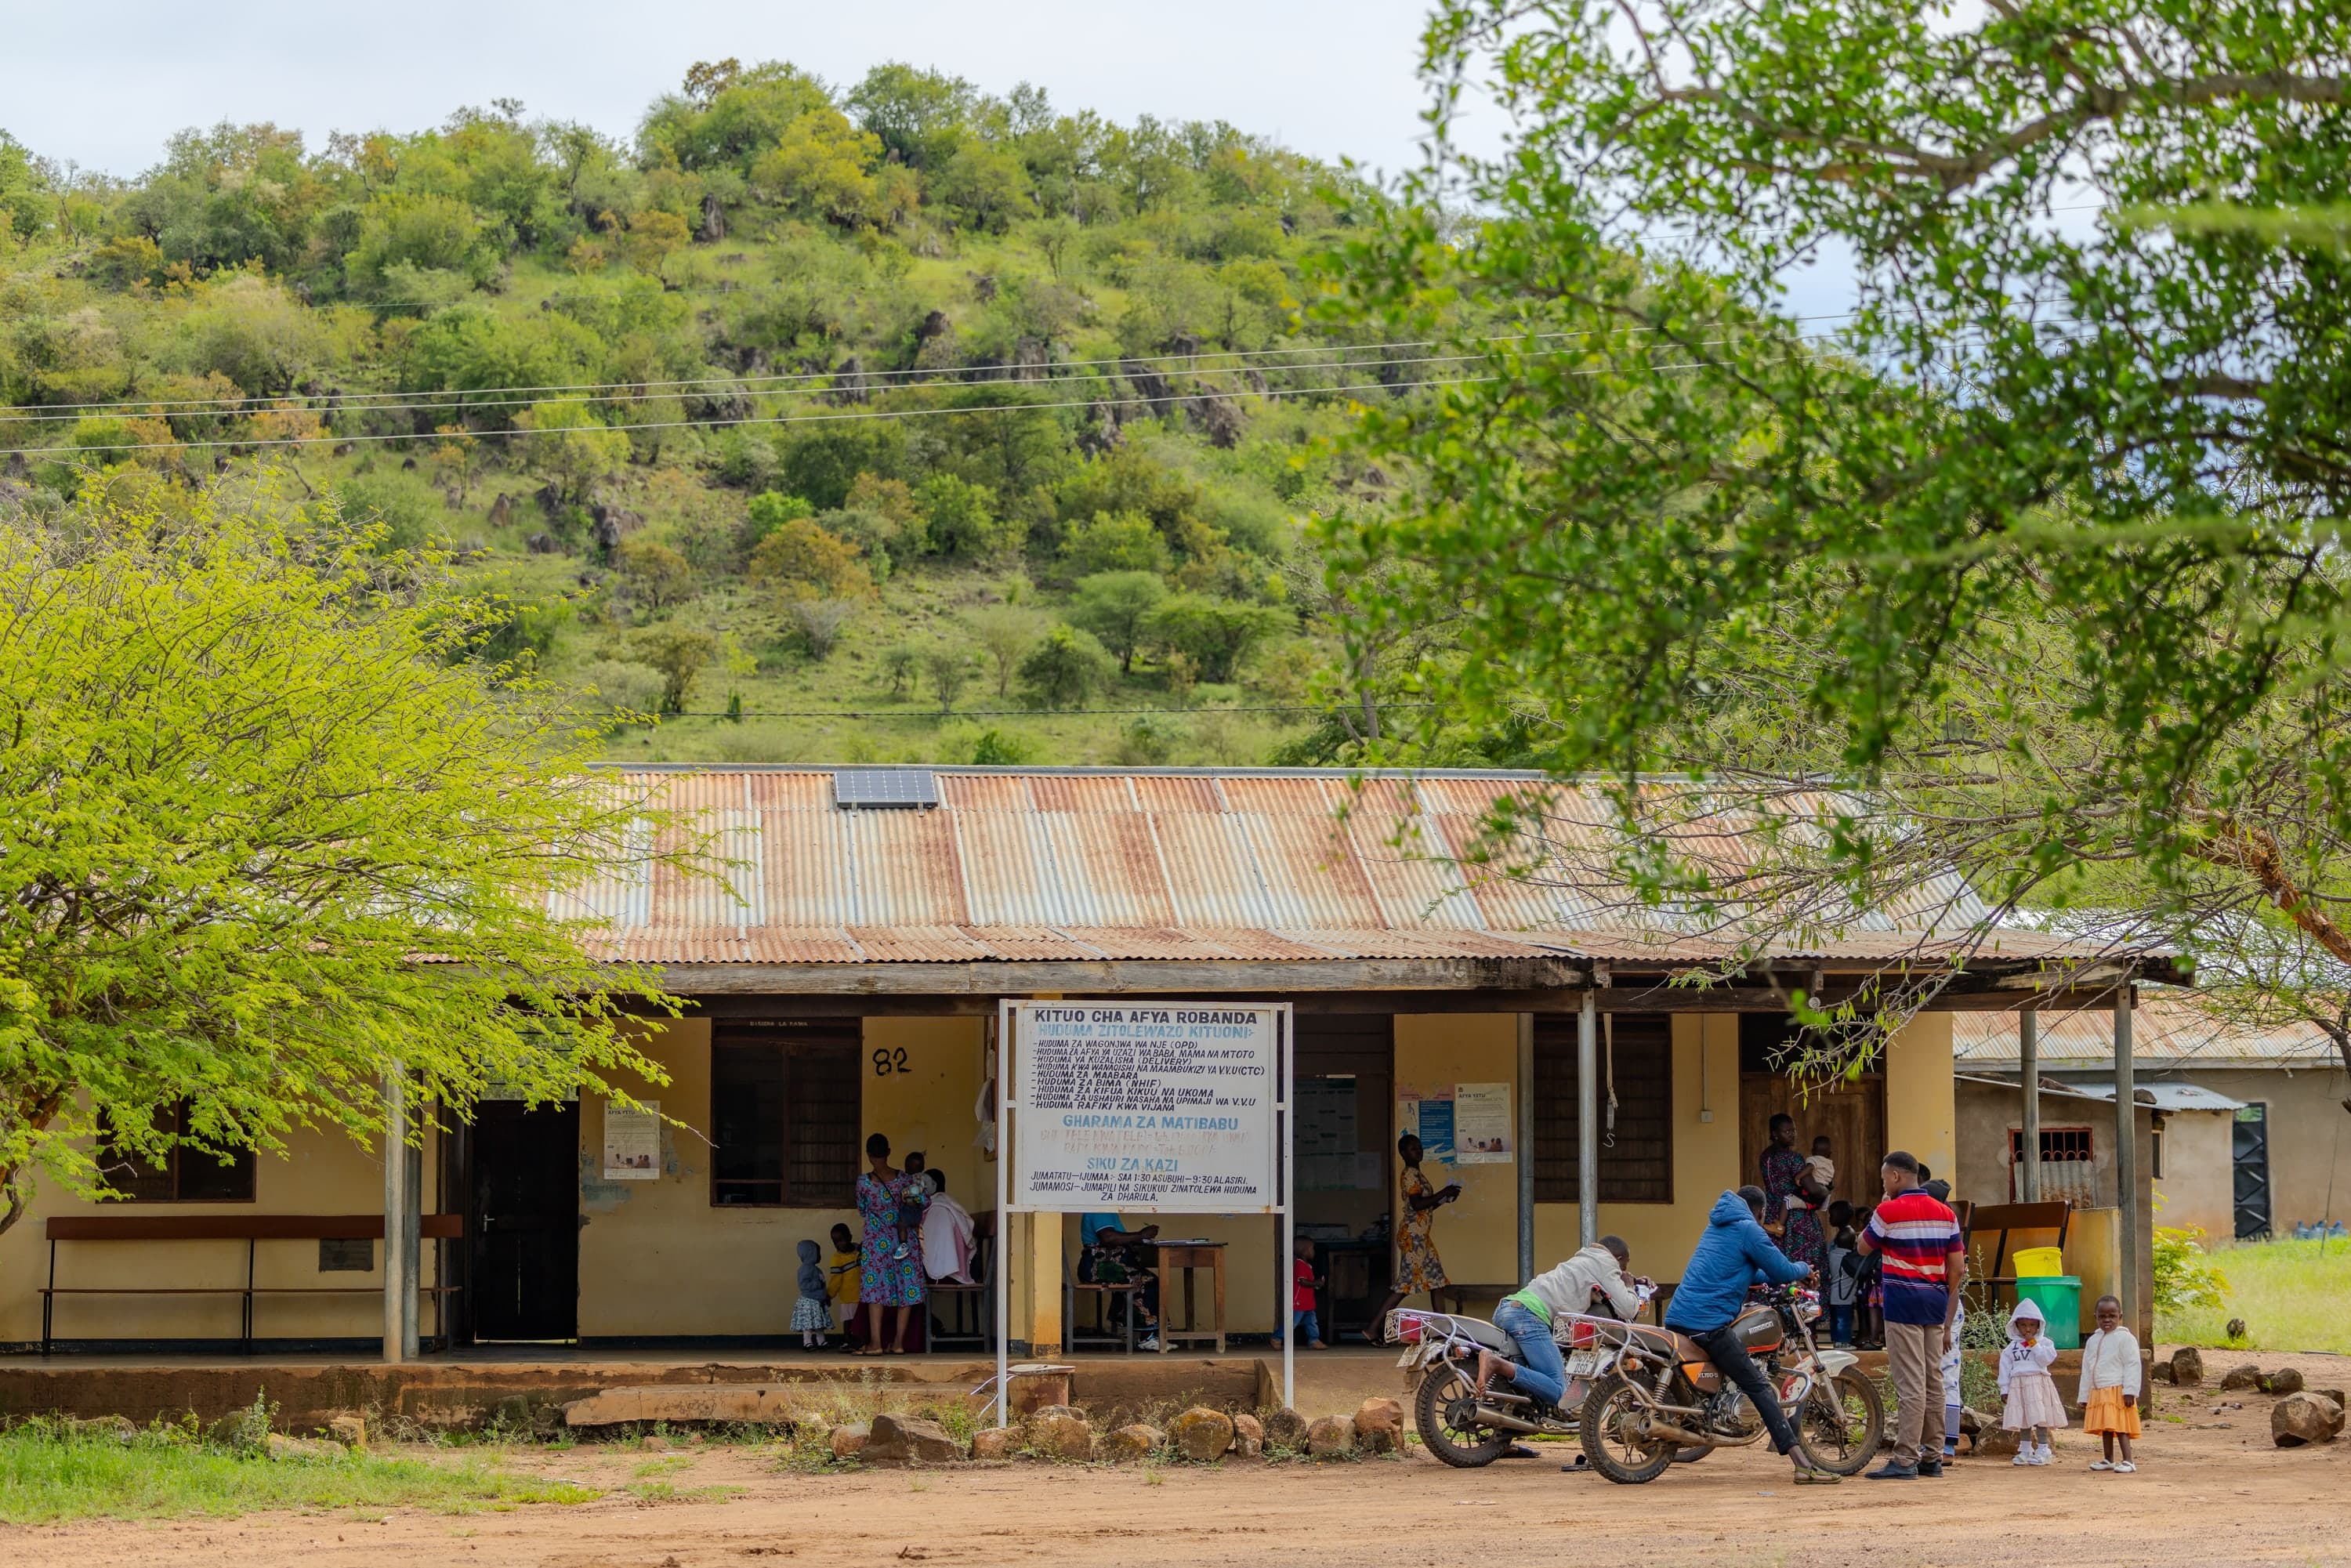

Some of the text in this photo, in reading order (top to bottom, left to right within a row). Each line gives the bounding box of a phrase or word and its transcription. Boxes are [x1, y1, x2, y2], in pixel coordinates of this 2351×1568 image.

[1034, 1010, 1257, 1024] KITUO CHA AFYA ROBANDA
[1039, 1023, 1093, 1036] HUDUMA
[1098, 1025, 1183, 1037] ZITOLEWAZO
[1170, 1041, 1198, 1049] (OPD)
[1220, 1050, 1255, 1059] MTOTO
[872, 1047, 912, 1076] 82
[1138, 1056, 1192, 1066] (DELIVERY)
[1150, 1065, 1205, 1074] MAAMBUKIZI
[1208, 1066, 1216, 1074] YA
[1092, 1071, 1138, 1080] MAABARA
[1126, 1079, 1161, 1088] (NHIF)
[1127, 1088, 1157, 1096] KIKUU
[1161, 1088, 1175, 1096] NA
[1178, 1088, 1214, 1098] UKOMA
[1233, 1098, 1256, 1106] V.V.U
[1063, 1114, 1238, 1130] GHARAMA ZA MATIBABU
[1087, 1157, 1178, 1171] SIKU ZA KAZI
[1118, 1173, 1132, 1182] SAA
[1118, 1183, 1129, 1192] NA
[1133, 1184, 1168, 1193] SIKUKUU
[1171, 1184, 1222, 1193] ZINATOLEWA
[1223, 1186, 1257, 1194] HUDUMA
[1101, 1192, 1158, 1201] ZA DHARULA.
